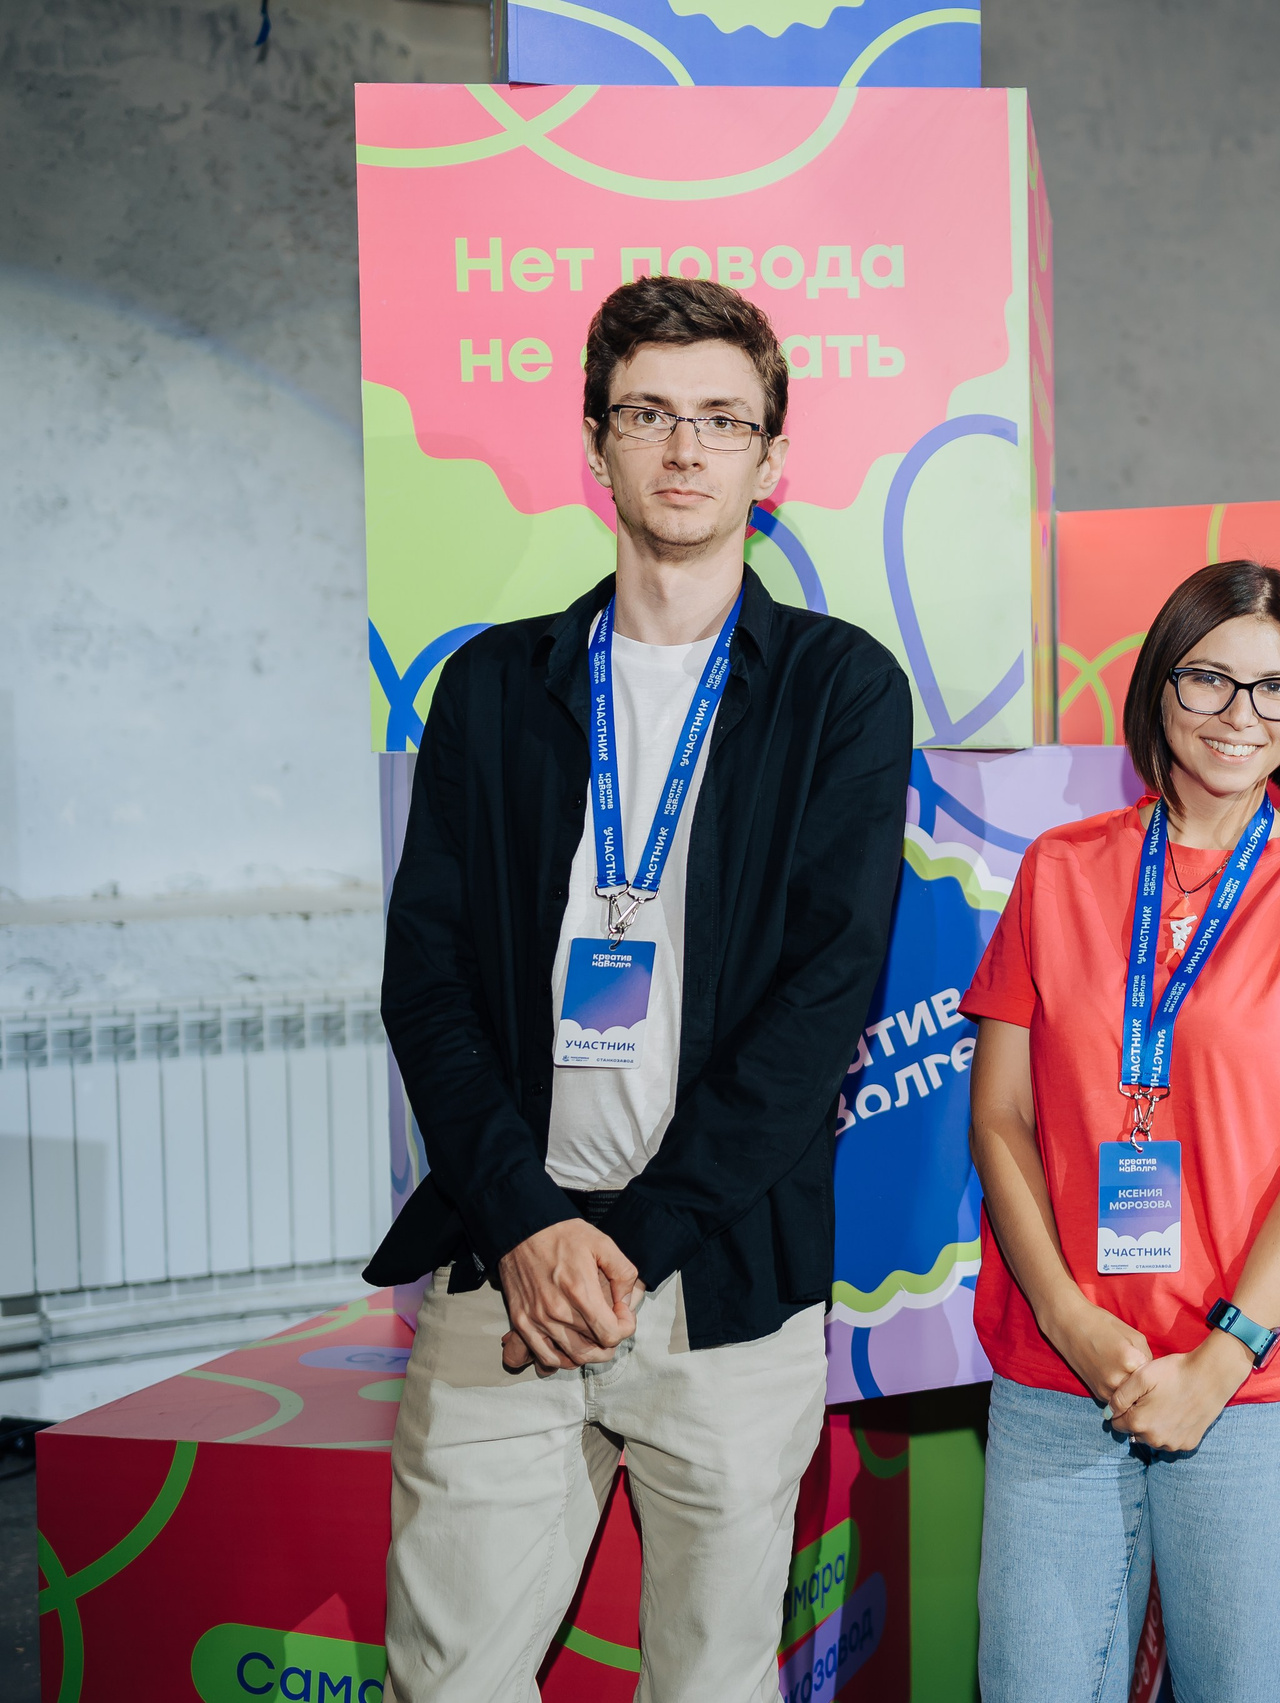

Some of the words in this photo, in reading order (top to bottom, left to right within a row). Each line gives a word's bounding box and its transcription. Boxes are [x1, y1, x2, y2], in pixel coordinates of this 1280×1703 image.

[455, 237, 594, 292] Нет
[620, 244, 905, 299] повода
[459, 337, 553, 383] не
[680, 698, 711, 767] УЧАСТНИК
[641, 826, 670, 890] ЧАСТНИК
[593, 953, 633, 963] креатив
[565, 1040, 636, 1052] УЧАСТНИК
[847, 987, 965, 1074] атив
[1131, 1018, 1143, 1085] ЧАСТНИК
[835, 1036, 977, 1137] Волге
[1118, 1158, 1157, 1167] креатив
[1109, 1200, 1172, 1211] МОРОЗОВА
[1118, 1188, 1163, 1199] КСЕНИЯ
[1103, 1247, 1172, 1257] УЧАСТНИК
